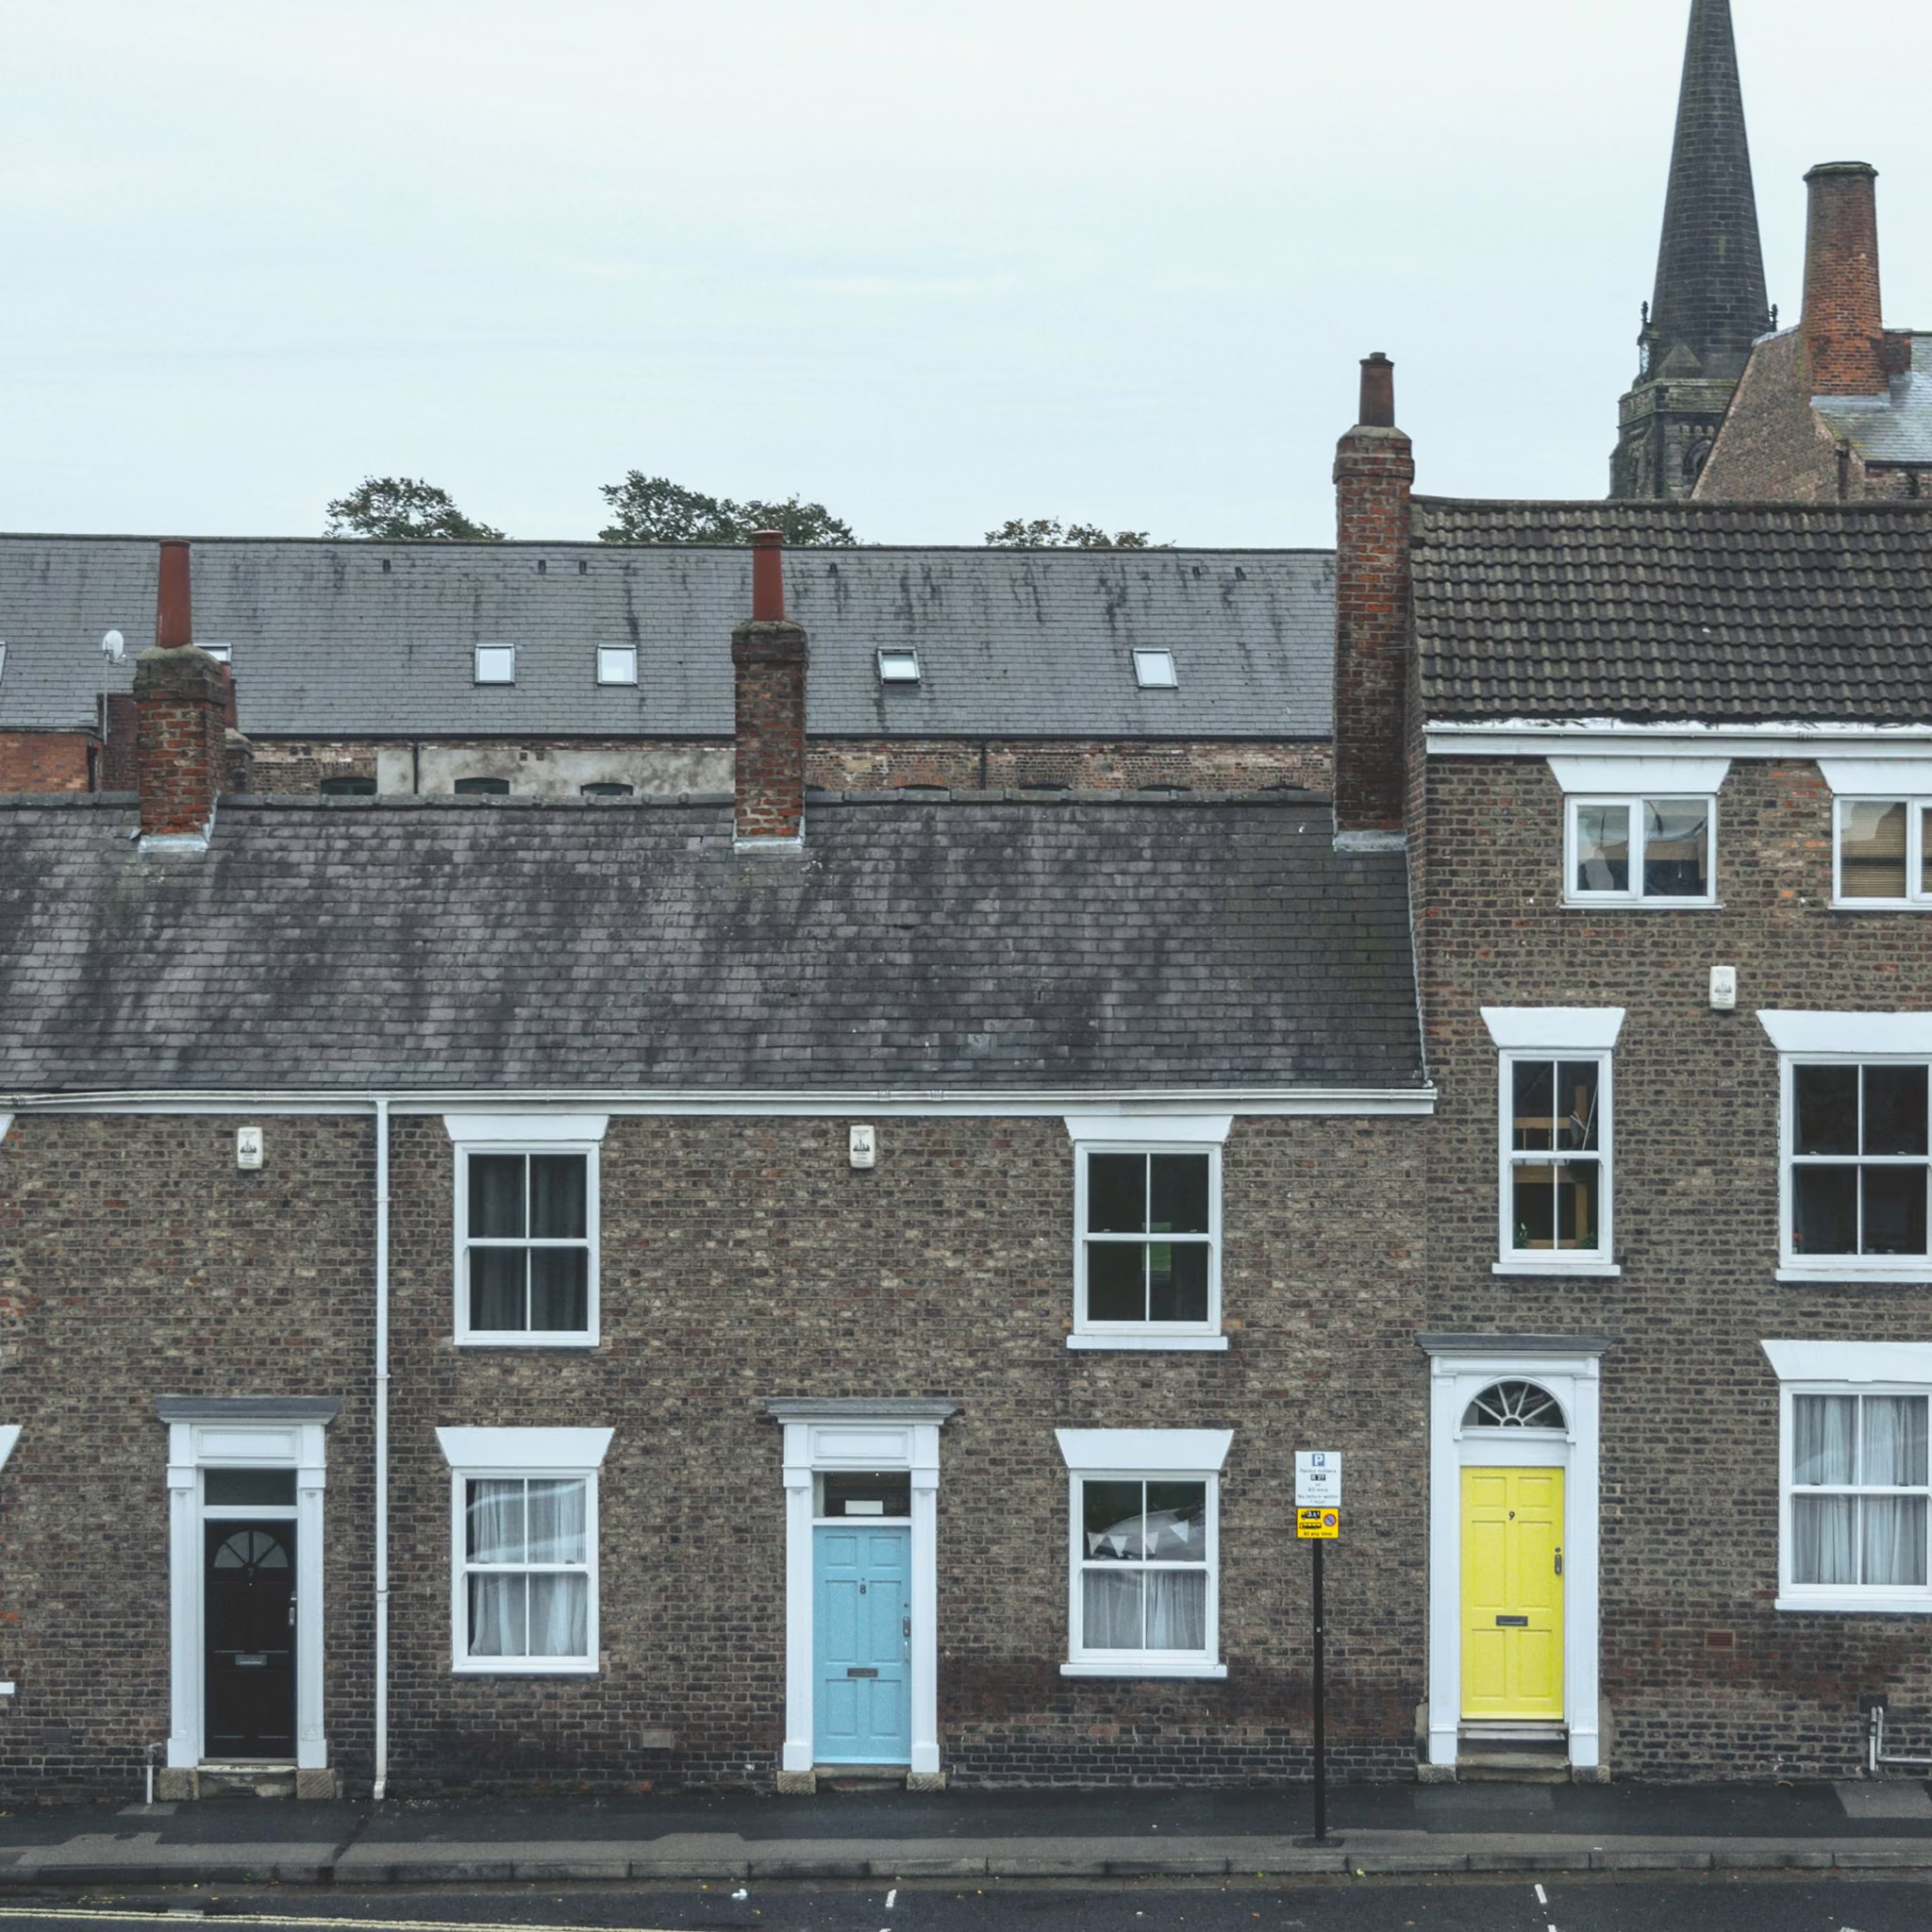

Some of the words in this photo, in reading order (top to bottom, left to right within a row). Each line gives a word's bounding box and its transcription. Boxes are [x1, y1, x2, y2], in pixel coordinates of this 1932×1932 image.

[1314, 1454, 1324, 1466] P
[1508, 1510, 1515, 1521] 9
[247, 1568, 254, 1577] 7
[859, 1584, 867, 1594] 8
